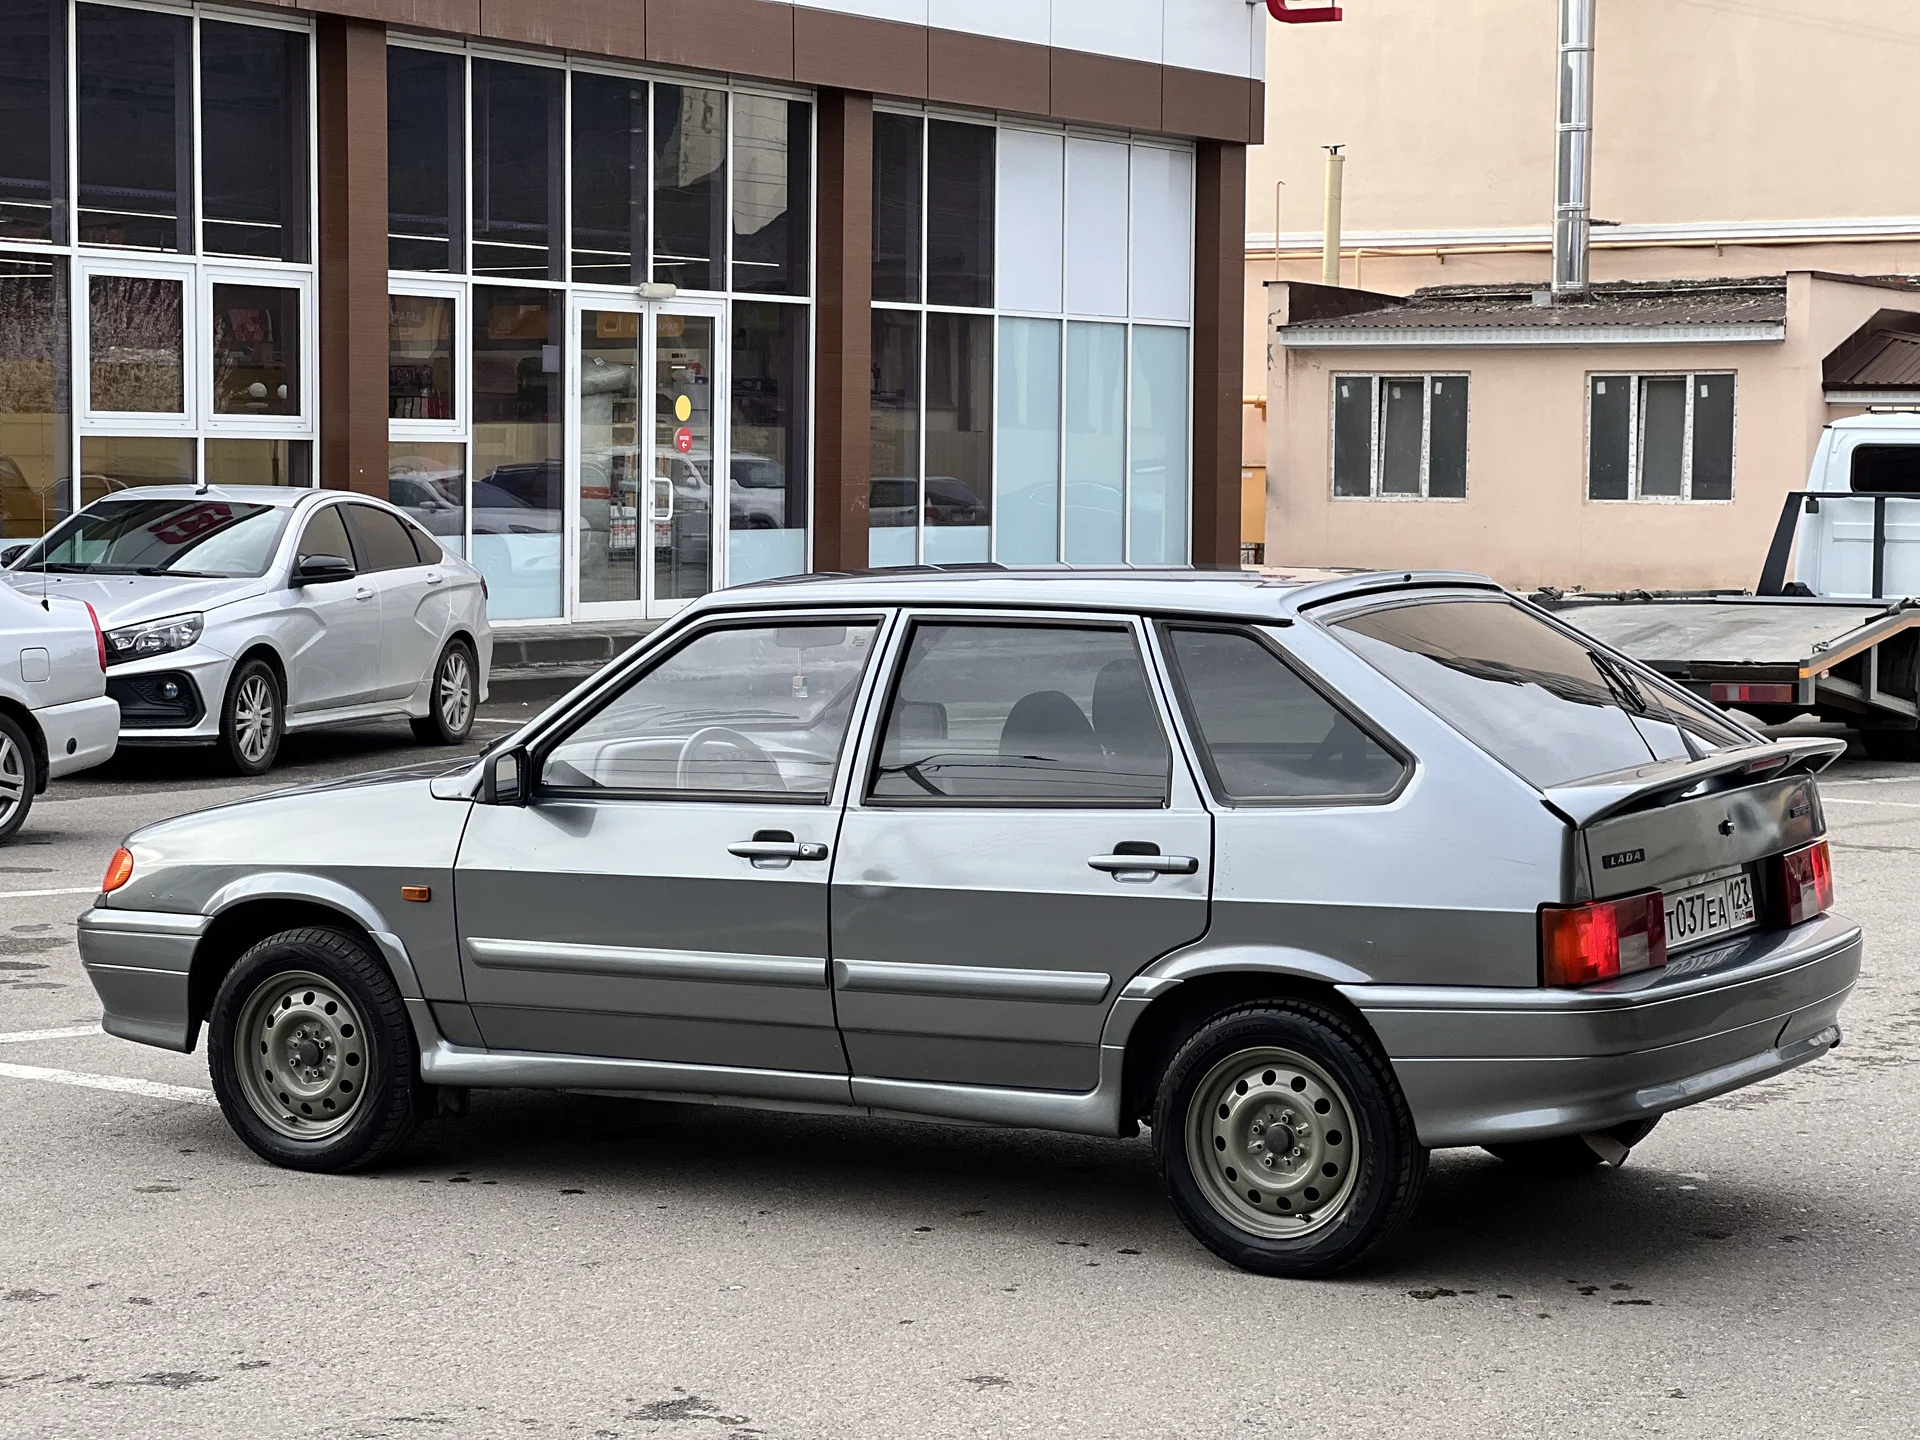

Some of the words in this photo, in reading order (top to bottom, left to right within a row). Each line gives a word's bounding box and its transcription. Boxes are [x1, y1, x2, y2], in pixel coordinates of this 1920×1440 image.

[1610, 850, 1641, 866] LADA
[1664, 892, 1728, 941] Т037ЕА
[1728, 877, 1751, 910] 123
[1734, 909, 1746, 922] RUS
